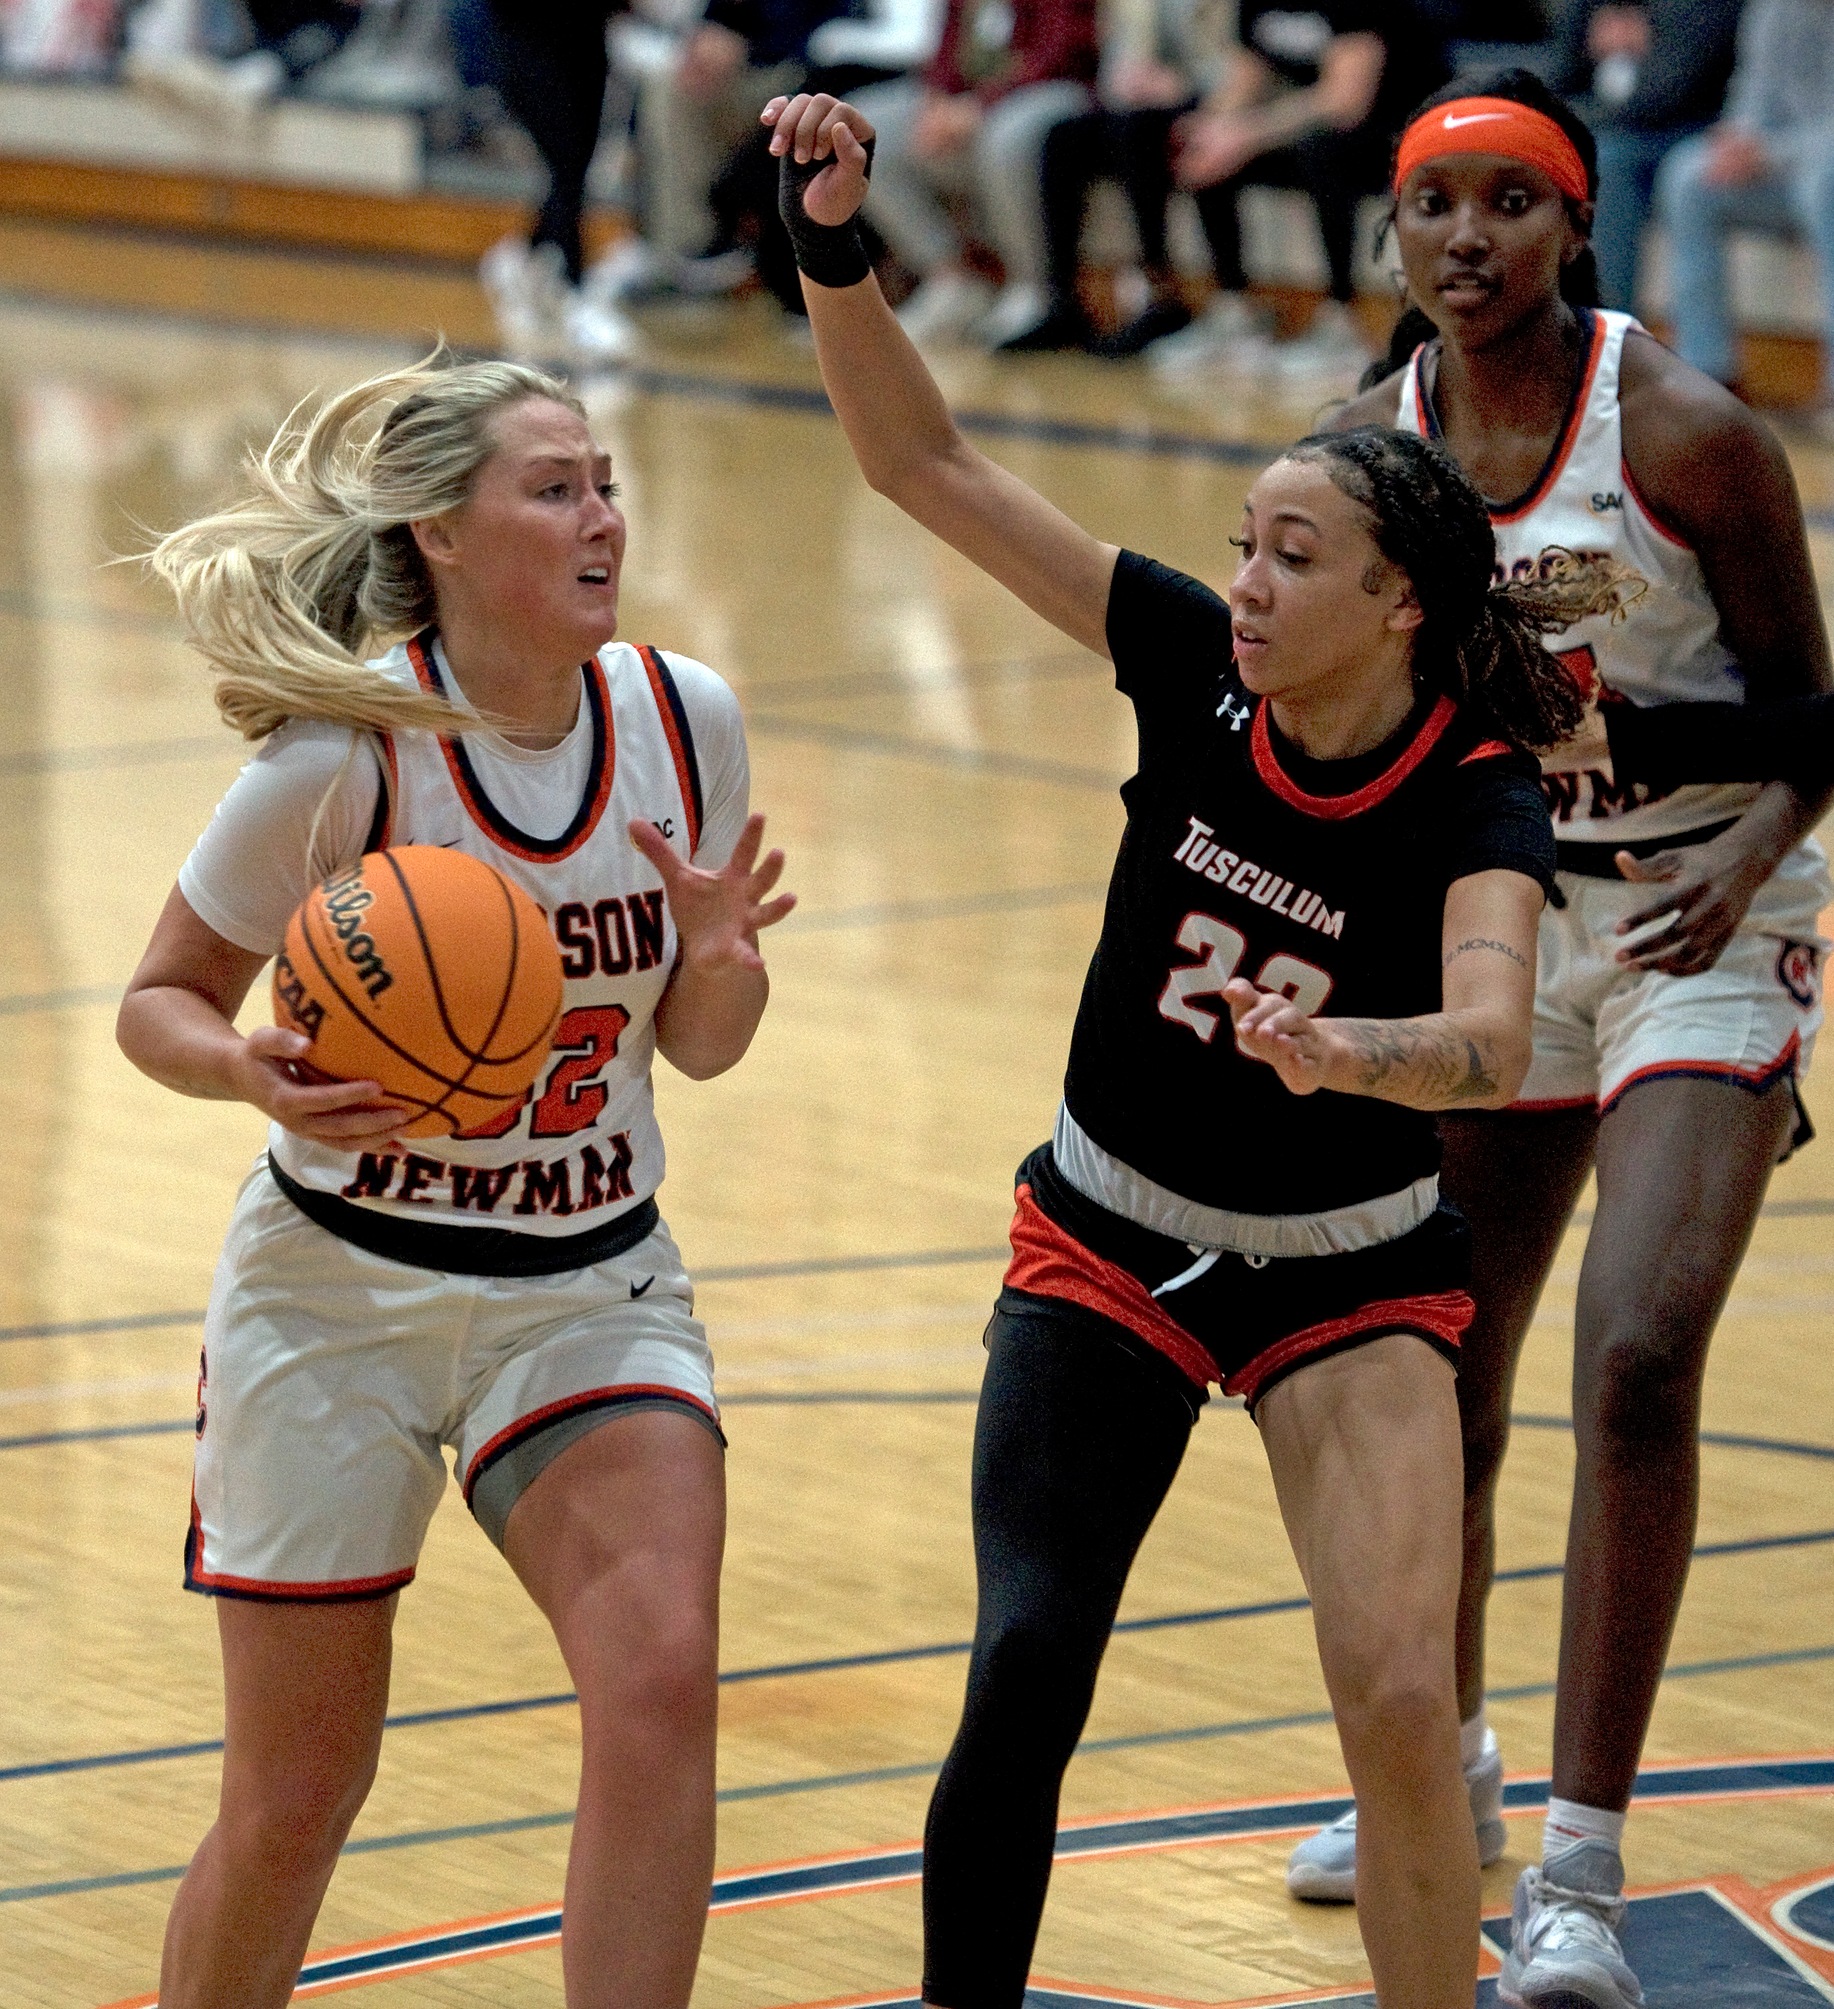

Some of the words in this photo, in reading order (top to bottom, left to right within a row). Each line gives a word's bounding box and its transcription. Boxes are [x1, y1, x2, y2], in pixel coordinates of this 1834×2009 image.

[536, 886, 665, 980] SON
[275, 953, 327, 1043] CAA
[449, 1002, 631, 1141] 2
[341, 1129, 636, 1217] NEWMAN
